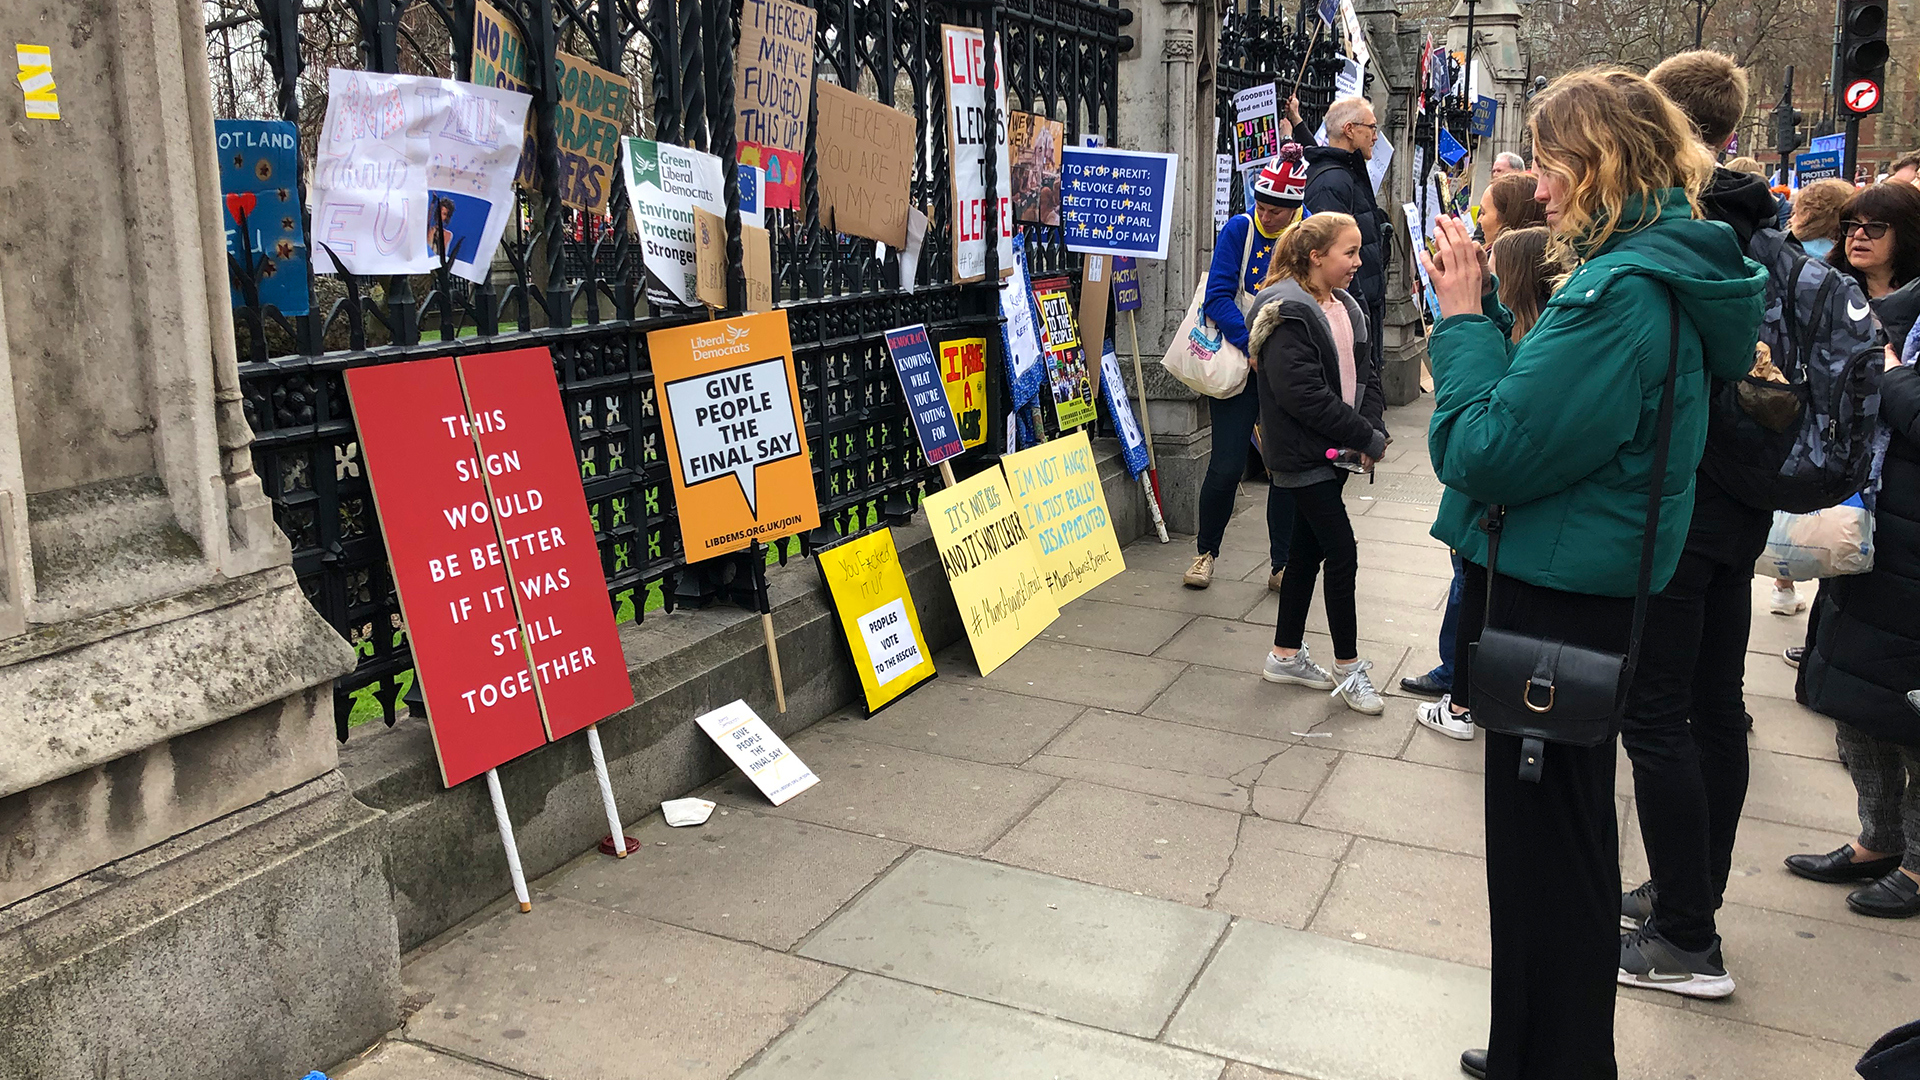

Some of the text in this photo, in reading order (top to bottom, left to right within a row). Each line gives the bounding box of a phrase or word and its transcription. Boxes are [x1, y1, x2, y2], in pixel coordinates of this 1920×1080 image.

[754, 0, 813, 46] THERESA
[477, 12, 500, 62] NO
[758, 36, 808, 78] MAY'VE
[744, 67, 803, 119] FUDGED
[1237, 104, 1251, 114] ased
[1261, 98, 1273, 108] LIES
[333, 70, 406, 143] AND
[406, 86, 441, 139] I
[741, 109, 804, 154] THIS UP!
[819, 92, 901, 150] THERESA
[1237, 115, 1274, 138] PUT IT
[218, 131, 295, 150] OTLAND
[1239, 129, 1276, 151] TO THE
[1239, 142, 1277, 164] PEOPLE
[660, 151, 691, 169] Green
[860, 150, 889, 186] ARE
[1067, 164, 1151, 180] TO STOP BREXIT:
[661, 166, 693, 184] Liberal
[1801, 169, 1836, 180] PROTEST
[663, 181, 714, 202] Democrats
[1074, 181, 1152, 197] REVOKE ART 50
[845, 184, 877, 225] MY
[881, 193, 907, 229] SID
[1095, 198, 1109, 209] TO
[1111, 199, 1125, 210] EU
[1127, 201, 1153, 212] PARL
[315, 198, 409, 257] EU
[960, 198, 1011, 242] LEAE
[1093, 213, 1107, 224] TO
[1126, 216, 1152, 228] PARL
[1070, 227, 1156, 244] THE END OF MAY
[1043, 299, 1058, 317] PUT
[1059, 298, 1067, 315] IT
[1047, 316, 1057, 332] TO
[1056, 314, 1071, 330] THE
[690, 332, 726, 350] Liberal
[888, 331, 927, 349] DEMOCRACY
[1051, 328, 1074, 345] PEOPLE
[692, 343, 750, 362] Democrats
[898, 352, 932, 372] KNOWING
[943, 346, 961, 383] I
[706, 372, 754, 400] GIVE
[910, 371, 931, 388] WHAT
[914, 388, 940, 408] YOU'RE
[964, 381, 972, 408] A
[695, 391, 773, 428] PEOPLE
[920, 406, 946, 425] VOTING
[442, 409, 507, 439] THIS
[718, 418, 759, 446] THE
[932, 425, 946, 441] FOR
[690, 432, 793, 478] FINAL SAY
[927, 439, 961, 462] THIS TIME
[455, 450, 521, 483] SIGN
[1014, 468, 1035, 498] I'M
[1036, 456, 1059, 487] NOT
[443, 489, 543, 530] WOULD
[944, 484, 1001, 534] IT'S NOT BIG
[1023, 480, 1096, 530] I'M REALLY
[704, 514, 802, 549] LIBDEMS.ORG.UK/JOIN
[1038, 505, 1106, 556] DISAPPOINTED
[428, 527, 566, 583] BE BETTER
[941, 543, 967, 581] AND
[982, 523, 1000, 560] NOT
[998, 510, 1028, 551] CLEVER
[449, 568, 571, 624] IF IT WAS
[861, 571, 884, 599] IT UP
[869, 611, 898, 634] PEOPLES
[490, 616, 562, 656] STILL
[880, 633, 900, 650] VOTE
[875, 645, 918, 675] TO THE RESCUE
[461, 646, 597, 714] TOGETHER
[732, 726, 750, 740] GIVE
[736, 733, 762, 751] PEOPLE
[749, 747, 783, 772] FINAL SAY
[750, 745, 766, 757] THE
